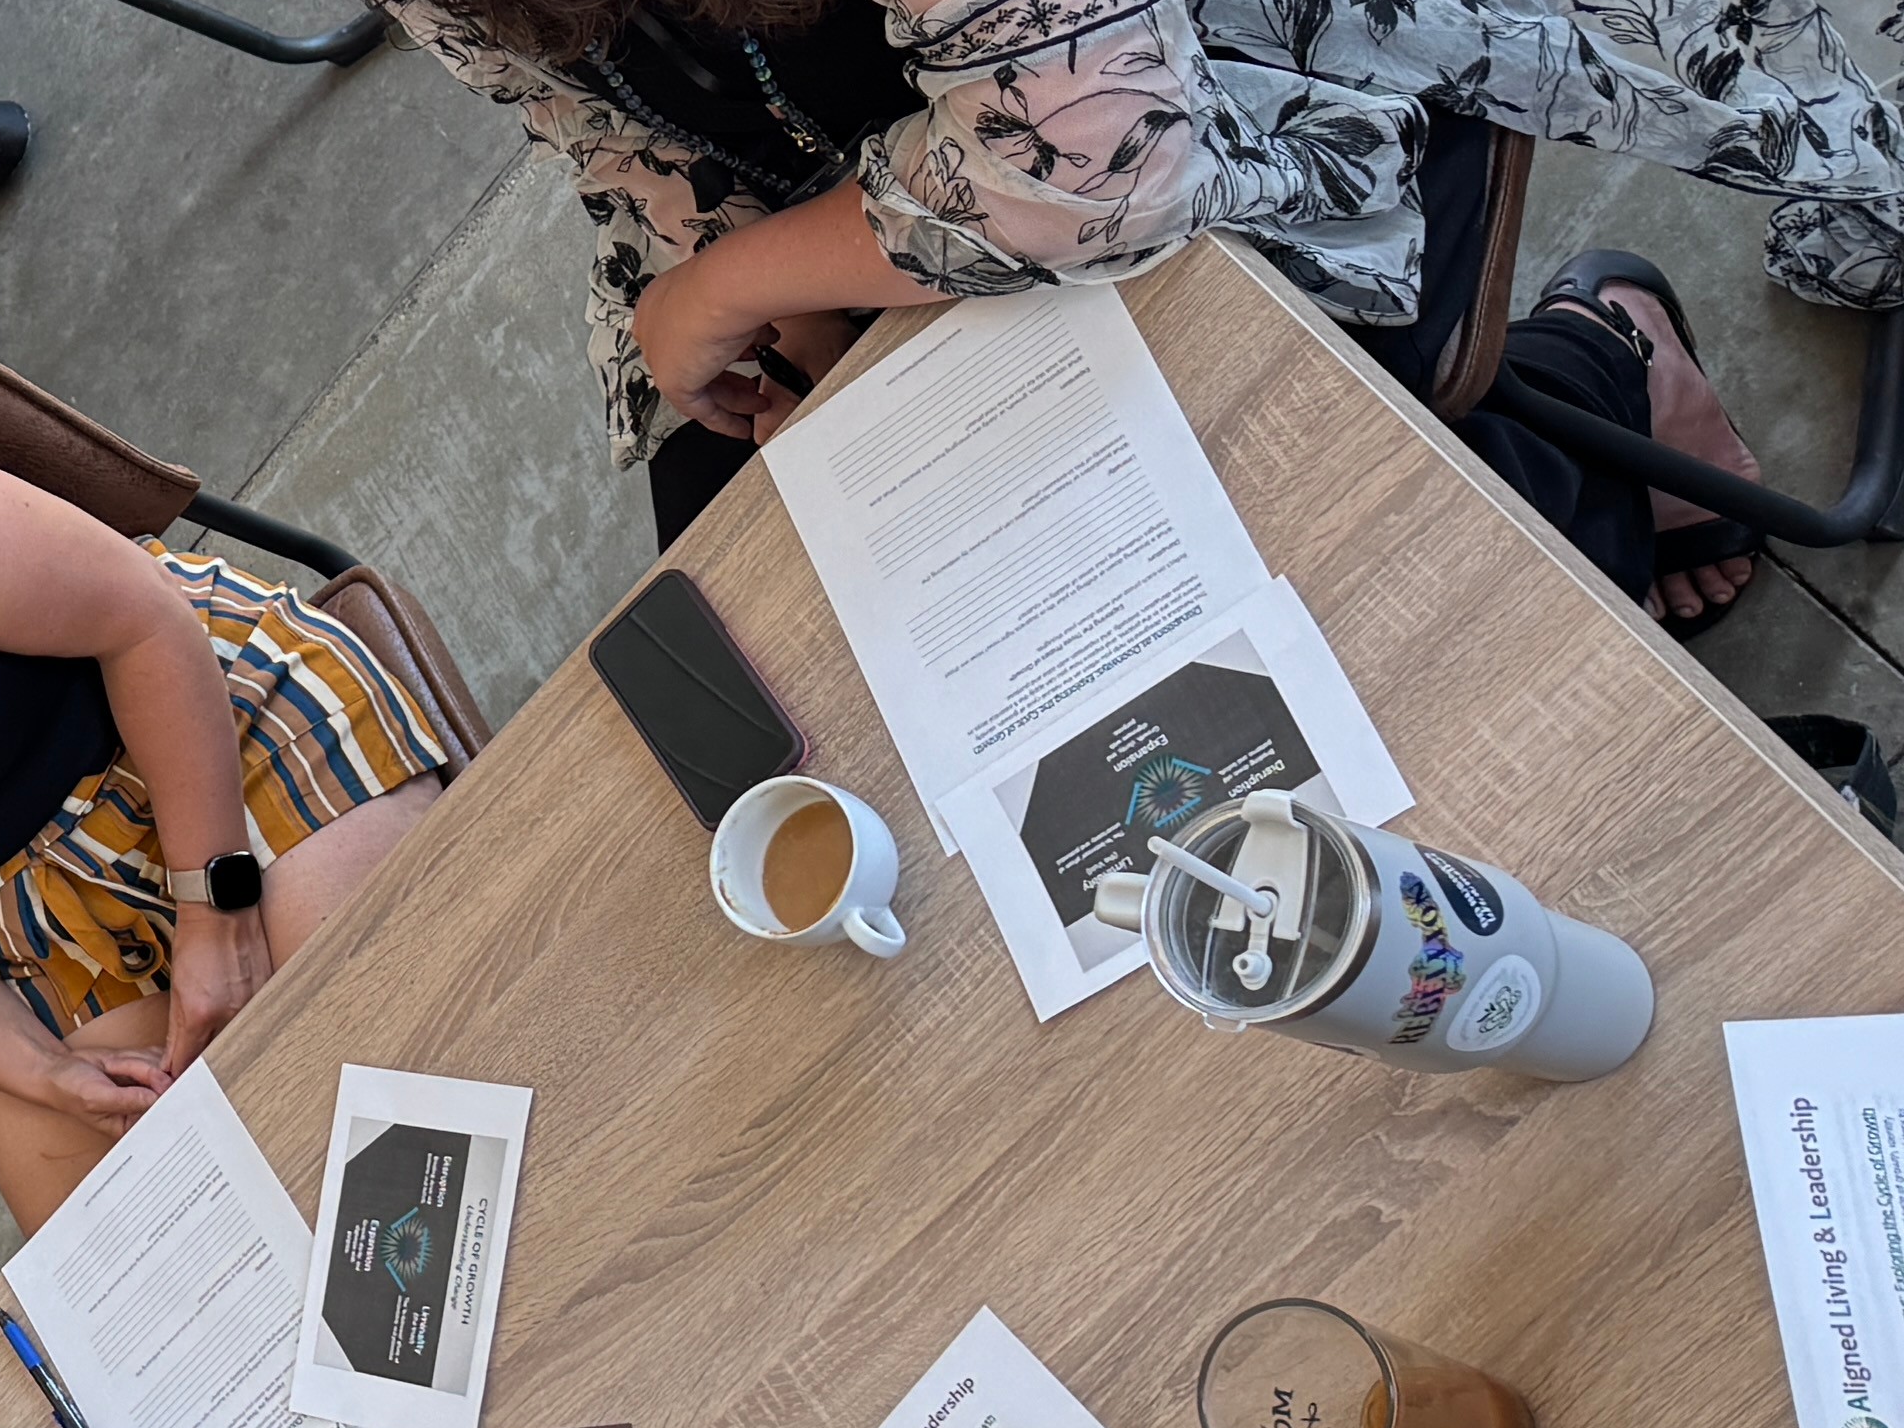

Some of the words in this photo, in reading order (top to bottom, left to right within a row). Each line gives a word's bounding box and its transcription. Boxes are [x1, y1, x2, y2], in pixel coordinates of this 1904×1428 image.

[1108, 734, 1168, 772] Expansion
[1228, 760, 1285, 797] Disruption
[1388, 881, 1447, 1044] REBELLION
[1862, 1108, 1882, 1155] Growth
[437, 1156, 452, 1207] Disruption
[1790, 1098, 1831, 1219] Leadership
[1869, 1154, 1886, 1170] of
[1874, 1171, 1893, 1206] Cycle
[474, 1198, 488, 1238] CYCLE
[1814, 1227, 1836, 1243] &
[1882, 1207, 1897, 1230] the
[362, 1220, 379, 1271] Expansion
[472, 1242, 481, 1260] OF
[462, 1264, 477, 1324] GROWTH
[1820, 1250, 1851, 1316] Living
[414, 1306, 430, 1354] Liminality
[1830, 1325, 1871, 1412] Aligned
